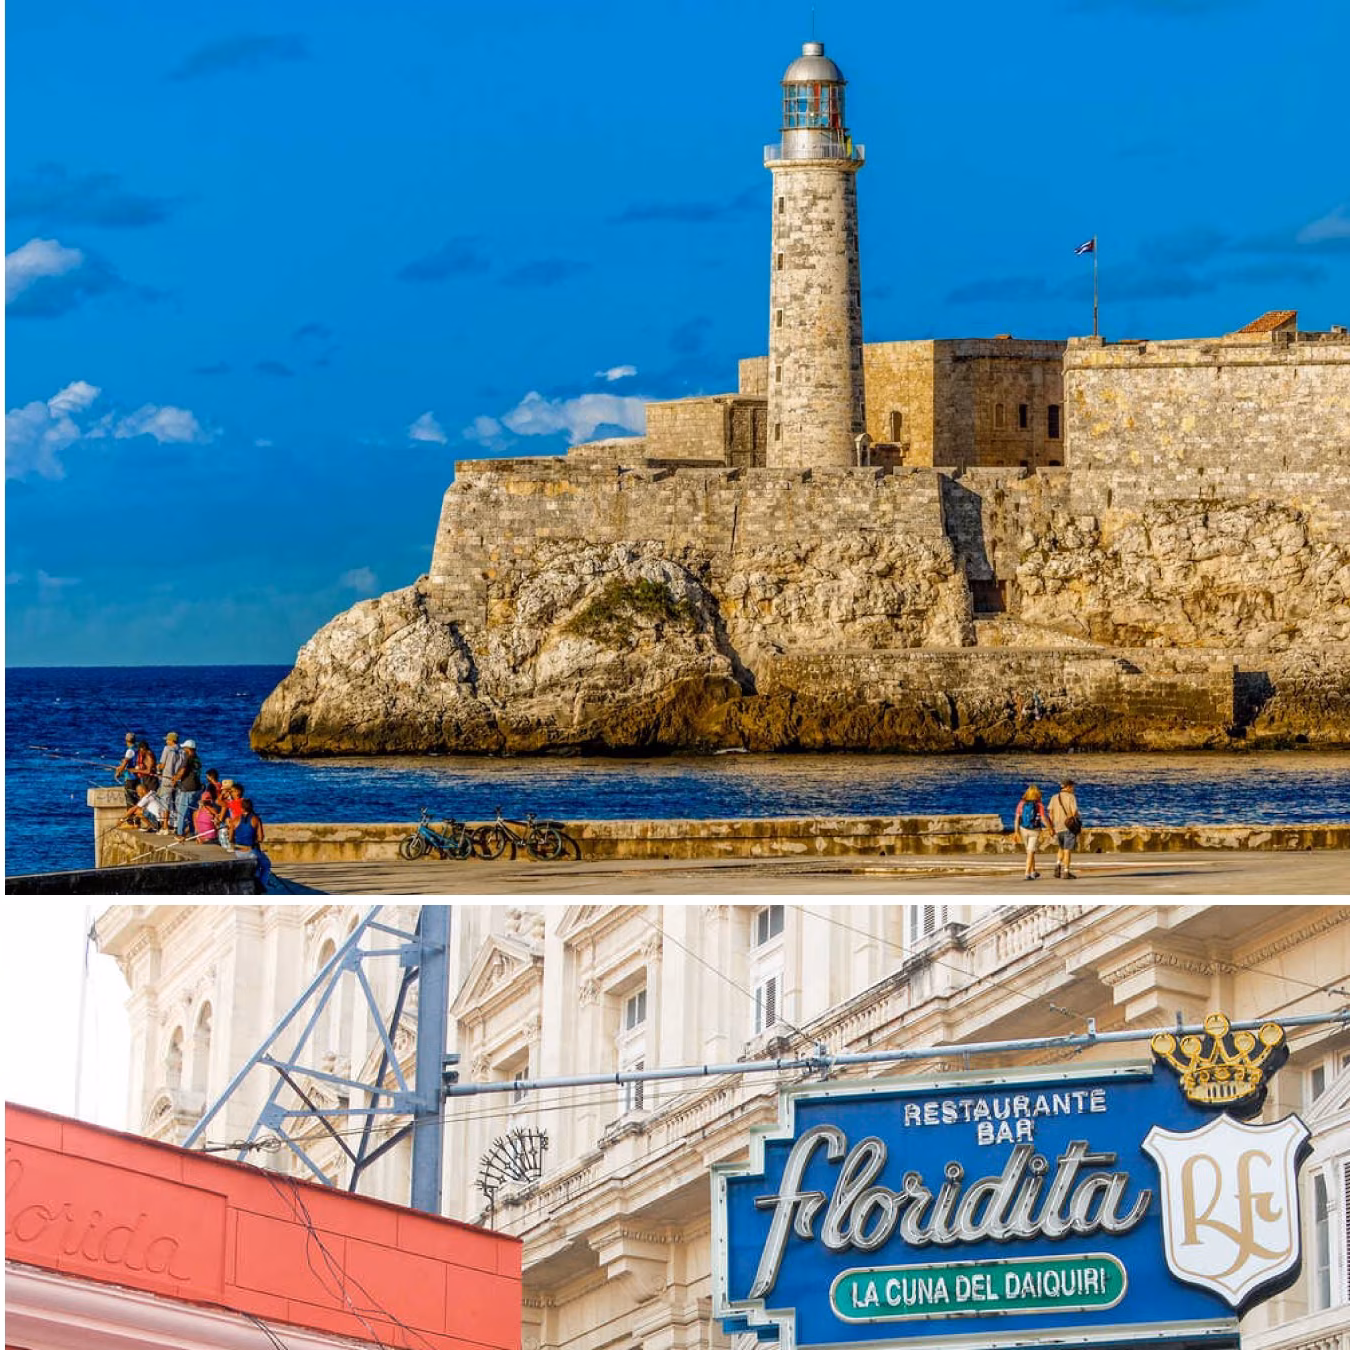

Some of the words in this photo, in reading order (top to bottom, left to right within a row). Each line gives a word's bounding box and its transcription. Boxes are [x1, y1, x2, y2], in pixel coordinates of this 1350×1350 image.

[904, 1088, 1107, 1126] RESTAURANTE
[978, 1117, 1035, 1146] BAR
[852, 1281, 880, 1308] LA
[886, 1277, 950, 1306] CUNA
[955, 1274, 999, 1303] DEL
[1005, 1267, 1107, 1299] DAIQUIRI
